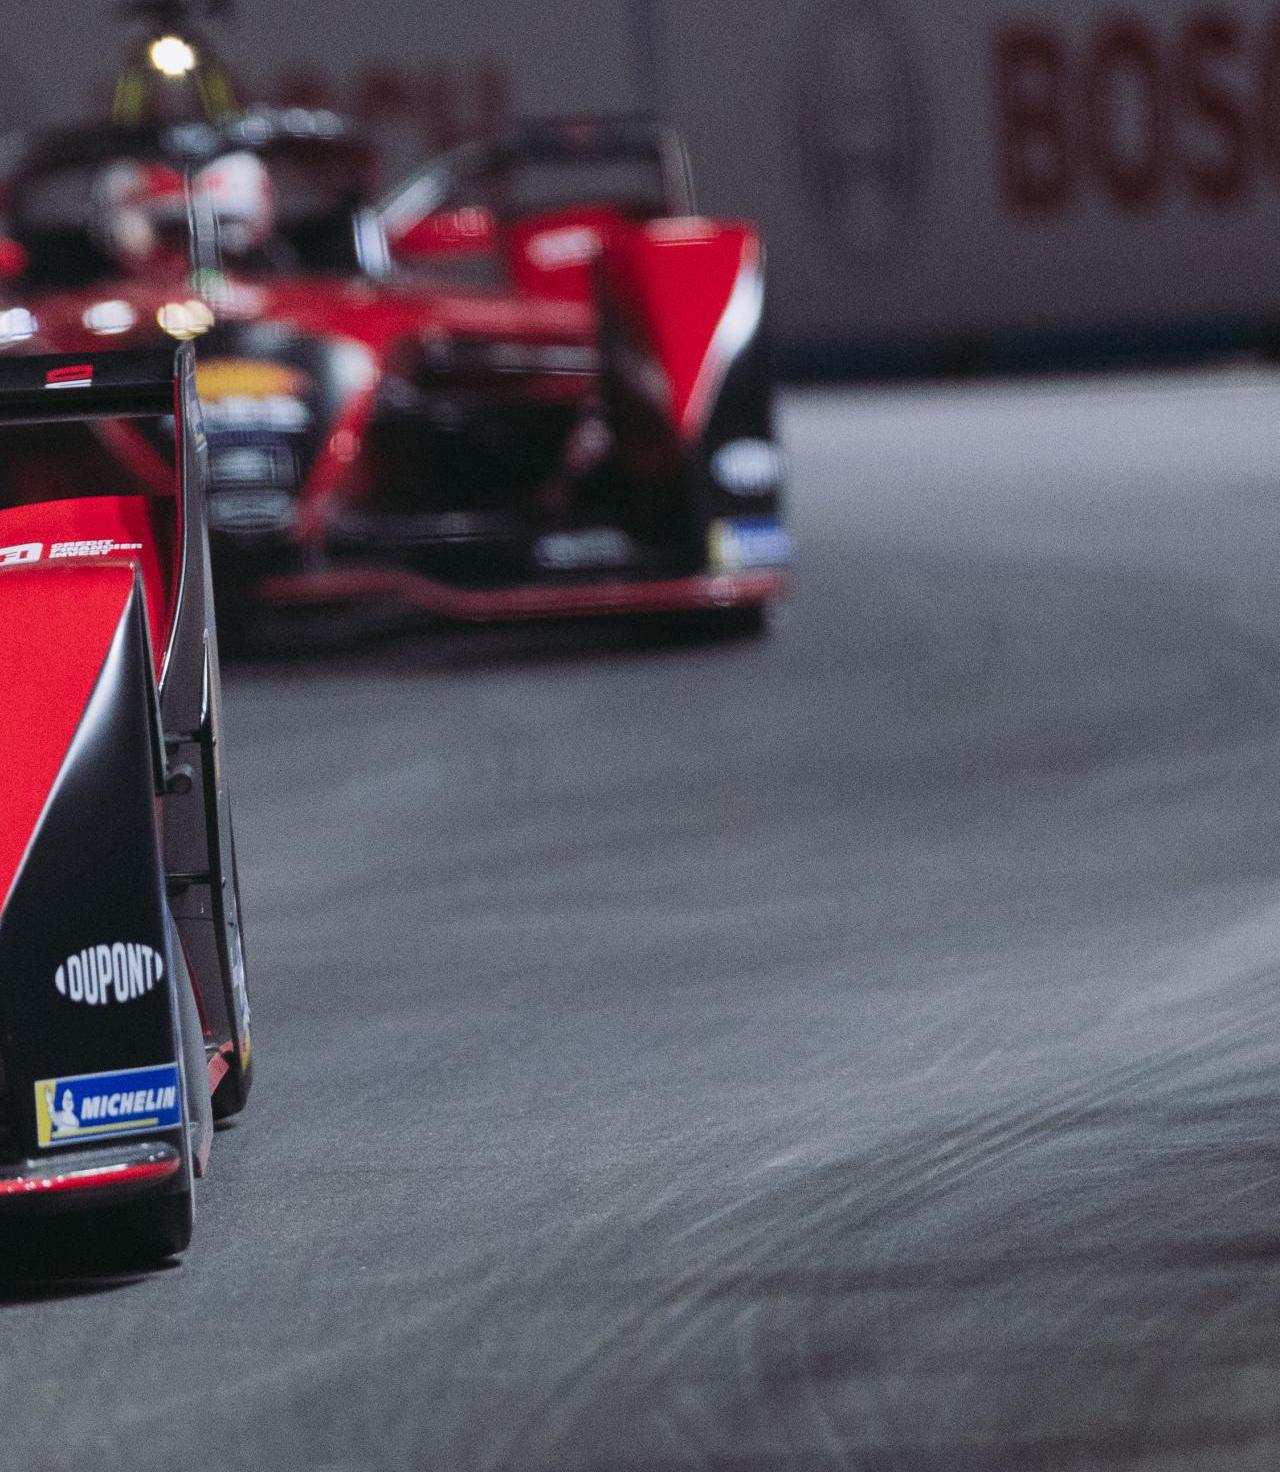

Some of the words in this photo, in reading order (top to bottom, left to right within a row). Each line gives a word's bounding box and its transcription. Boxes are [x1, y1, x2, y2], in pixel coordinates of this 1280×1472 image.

[986, 8, 1280, 218] BOS
[66, 942, 154, 1005] DUPONT
[80, 1085, 177, 1121] MICHELIN
